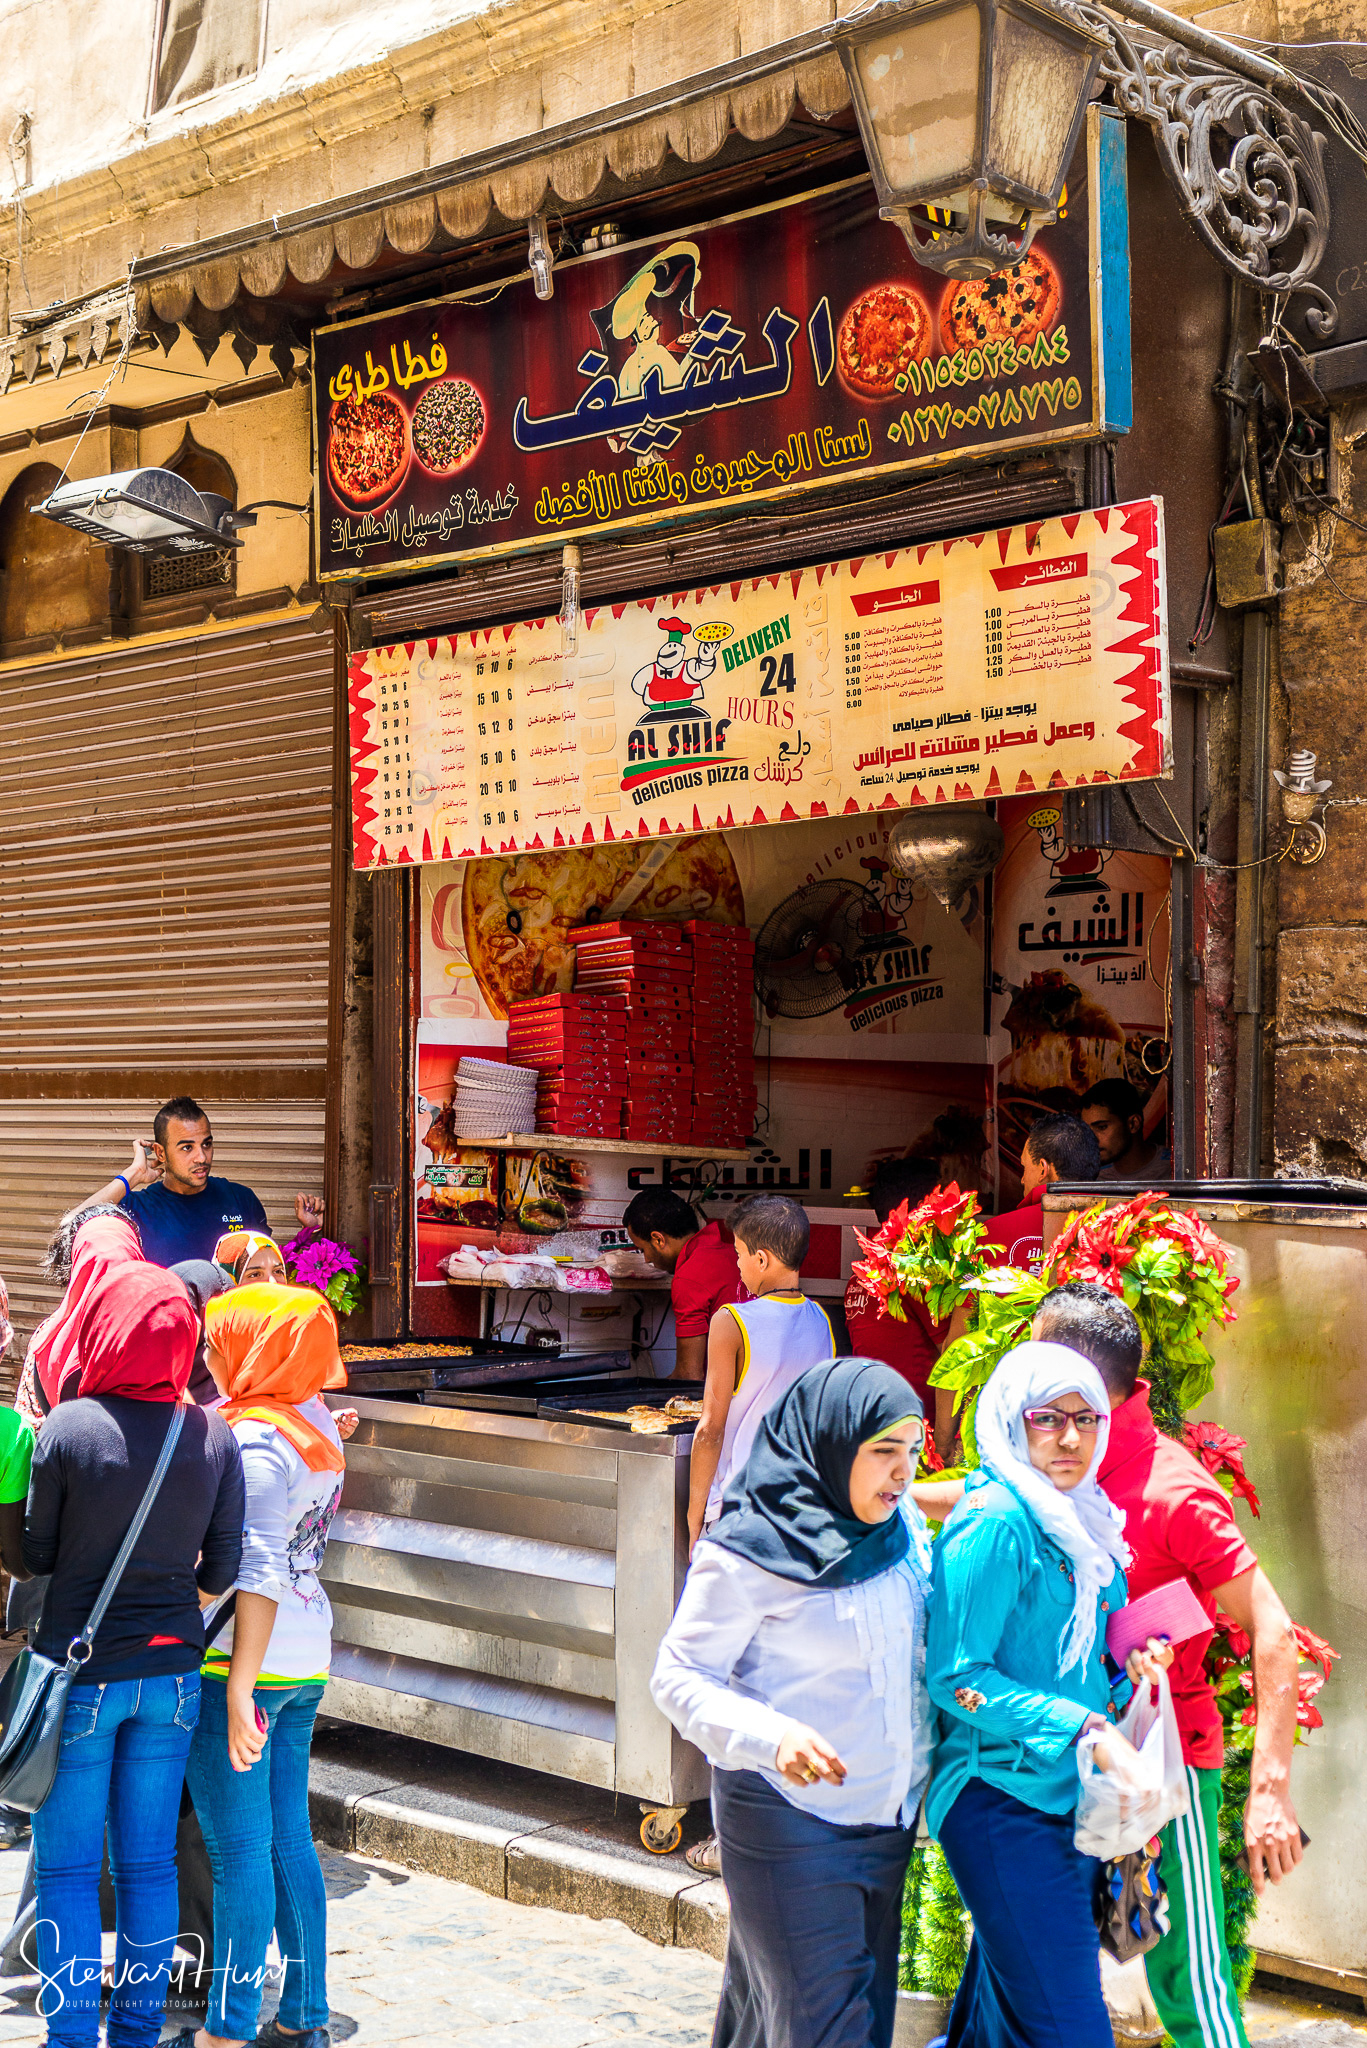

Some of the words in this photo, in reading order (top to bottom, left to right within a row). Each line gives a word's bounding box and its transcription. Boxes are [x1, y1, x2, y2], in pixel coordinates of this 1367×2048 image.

[894, 324, 1071, 397] ٠١١٥٤٥٢٤٠٨٤
[512, 295, 834, 455] الشيف
[814, 418, 872, 466] لسنا
[691, 433, 812, 495] الوحيدون
[623, 459, 688, 504] ولكننا
[466, 483, 519, 524] خدمة
[535, 469, 622, 525] الأفضل
[401, 494, 465, 548] توصيل
[330, 509, 399, 558] الطلبات
[1020, 560, 1077, 586] الفطائر
[871, 588, 922, 613] الحلو
[985, 608, 1002, 619] 1.00
[985, 620, 1002, 631] 1.00
[721, 613, 792, 673] DELIVERY
[844, 631, 860, 641] 5.00
[985, 632, 1002, 642] 1.00
[845, 643, 861, 652] 5.00
[986, 643, 1002, 654] 1.00
[476, 663, 484, 675] 15
[491, 661, 499, 673] 10
[507, 658, 513, 670] 6
[845, 654, 861, 664] 5.00
[986, 655, 1002, 666] 1.25
[759, 652, 797, 697] 24
[845, 665, 861, 675] 5.00
[986, 667, 1003, 678] 1.50
[846, 677, 860, 686] 1.50
[477, 693, 485, 705] 15
[491, 690, 499, 703] 10
[507, 688, 512, 700] 6
[846, 688, 861, 698] 5.00
[727, 696, 794, 729] HOURS
[846, 700, 862, 709] 6.00
[1005, 703, 1037, 717] يوجد
[935, 709, 972, 731] فطائر
[980, 706, 1004, 723] بيتزا
[478, 723, 486, 735] 15
[492, 721, 500, 733] 12
[508, 718, 513, 731] 8
[1043, 721, 1095, 747] وعمل
[628, 727, 658, 761] AL
[668, 718, 732, 758] SHIF
[779, 730, 811, 762] دلع
[919, 734, 980, 759] مشلتت
[984, 724, 1038, 755] فطير
[480, 753, 488, 765] 15
[495, 750, 503, 763] 10
[511, 749, 516, 761] 6
[852, 742, 917, 772] للعرائس
[754, 756, 804, 787] كرشك
[895, 768, 927, 784] توصيل
[928, 765, 954, 778] خدمة
[955, 762, 980, 774] يوجد
[480, 783, 489, 795] 20
[495, 781, 503, 794] 15
[508, 779, 517, 792] 10
[632, 771, 702, 806] delicious
[708, 765, 749, 786] pizza
[860, 775, 884, 787] ساعة
[885, 773, 894, 784] 24
[483, 813, 491, 825] 15
[497, 811, 506, 824] 10
[514, 809, 519, 822] 6
[1018, 892, 1144, 963] الشيف
[1097, 965, 1128, 985] بيتزا
[849, 994, 909, 1032] delicious
[910, 985, 944, 1006] pizza
